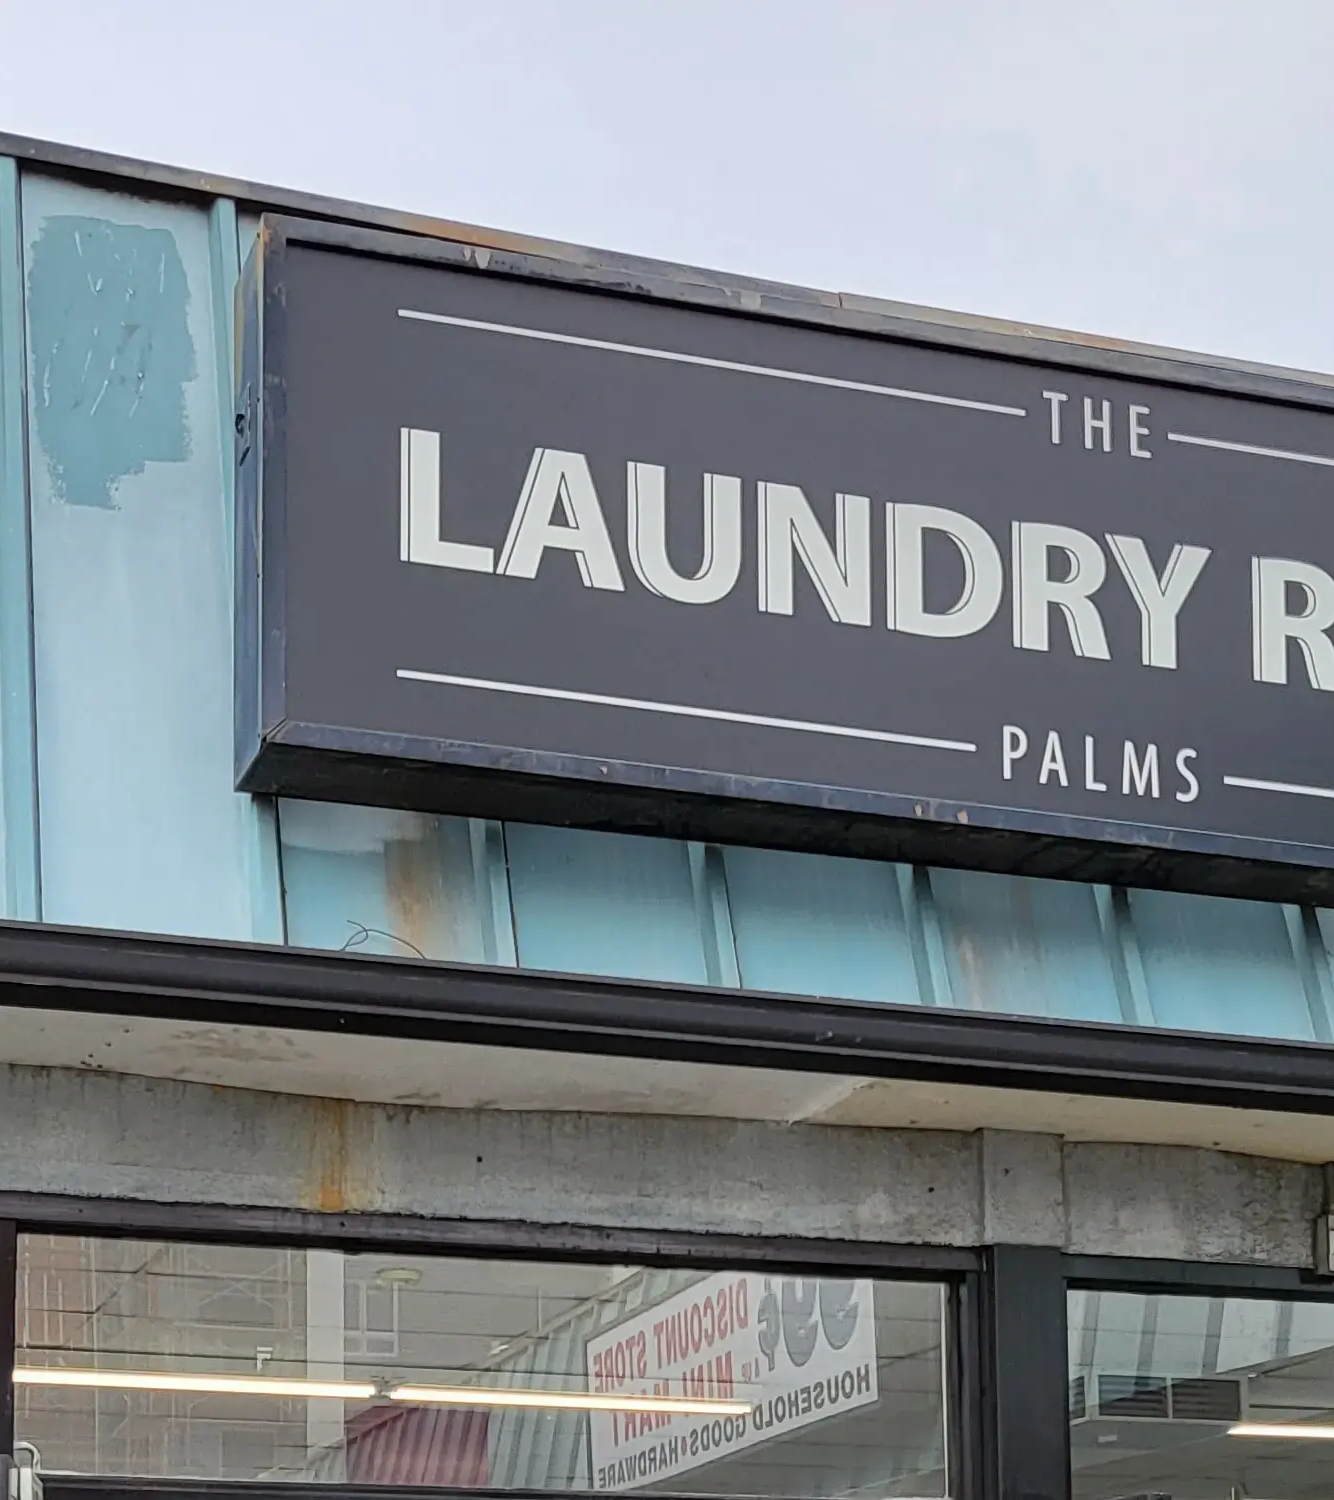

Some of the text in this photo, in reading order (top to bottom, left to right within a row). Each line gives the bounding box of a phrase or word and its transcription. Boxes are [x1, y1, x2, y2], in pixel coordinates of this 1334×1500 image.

[1042, 390, 1153, 459] THE
[400, 427, 1212, 670] LAUNDRY
[1003, 724, 1199, 803] PALMS
